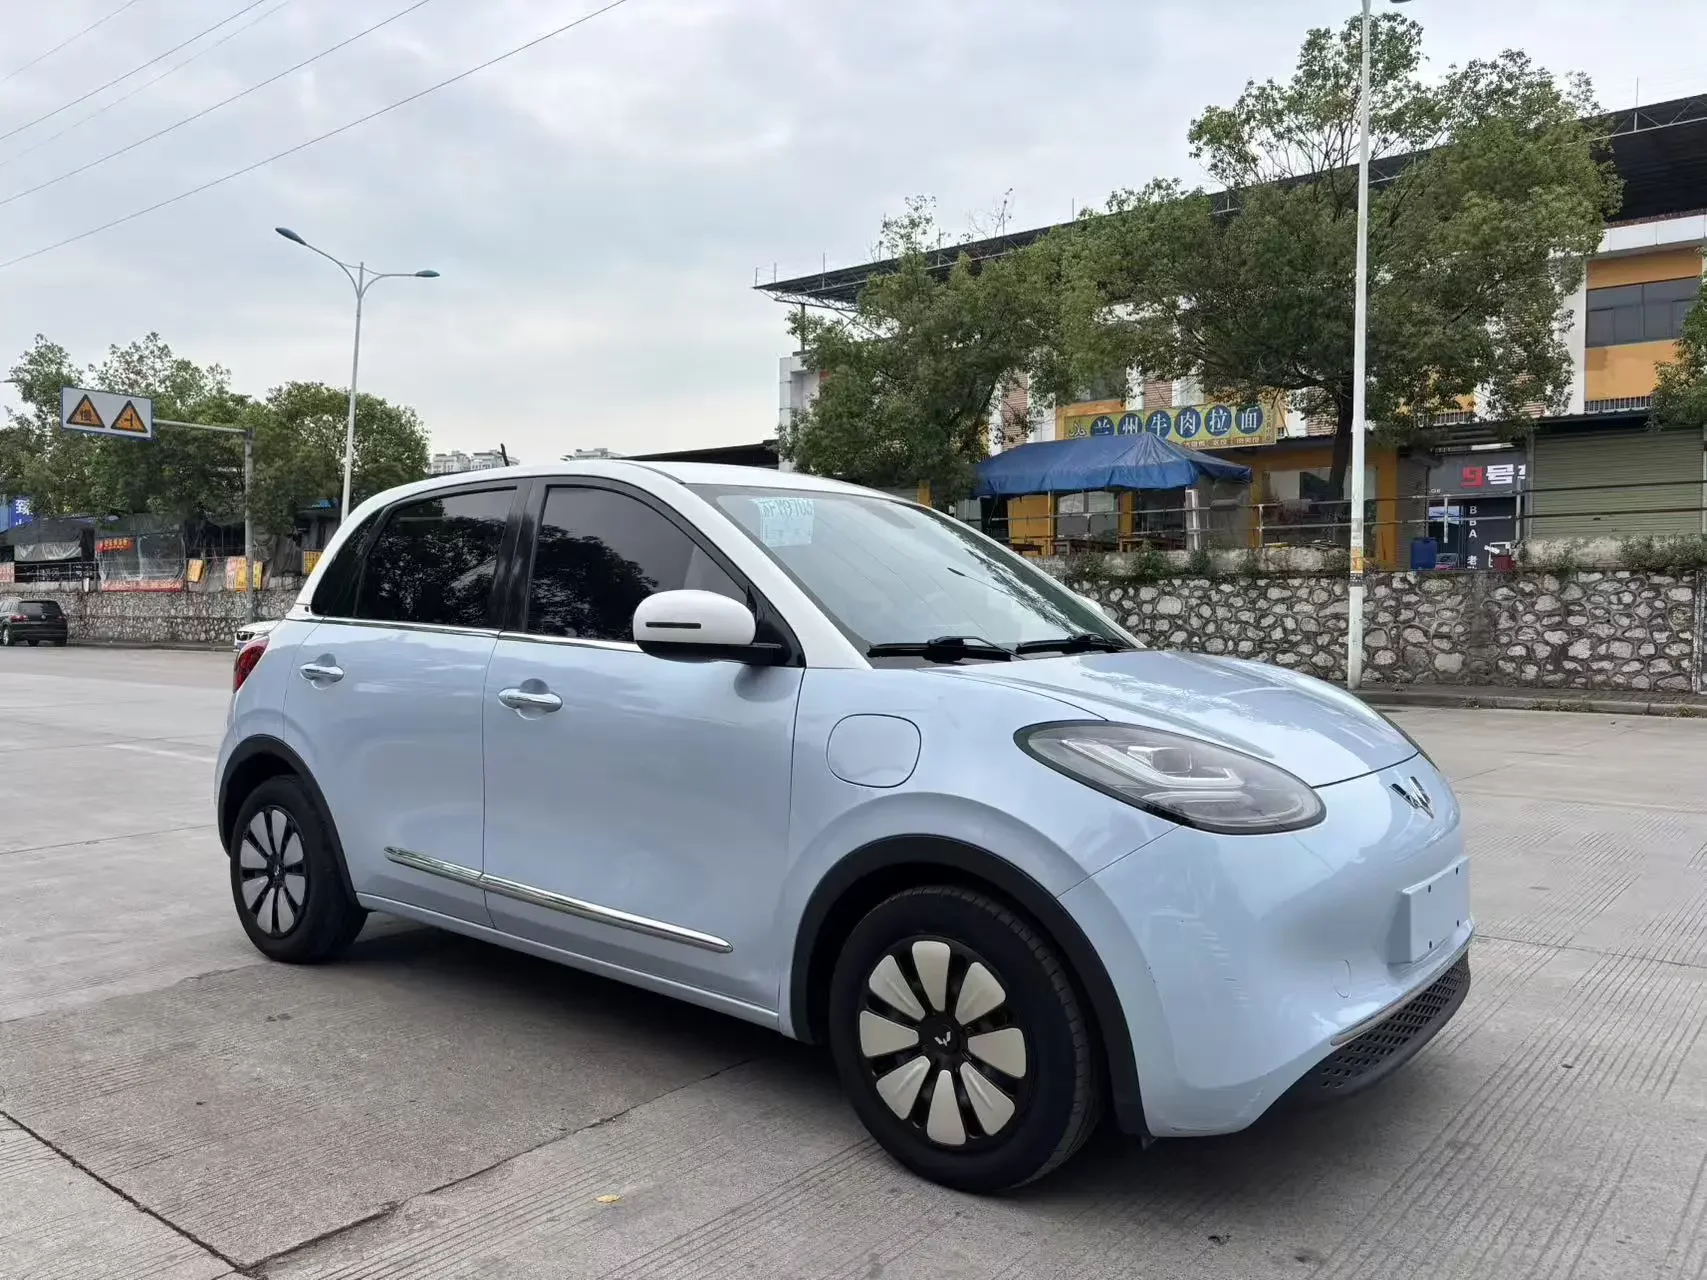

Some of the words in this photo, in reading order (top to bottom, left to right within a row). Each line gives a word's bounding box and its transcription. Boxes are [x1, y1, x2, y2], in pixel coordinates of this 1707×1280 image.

[1093, 407, 1259, 436] 兰州牛肉拉面
